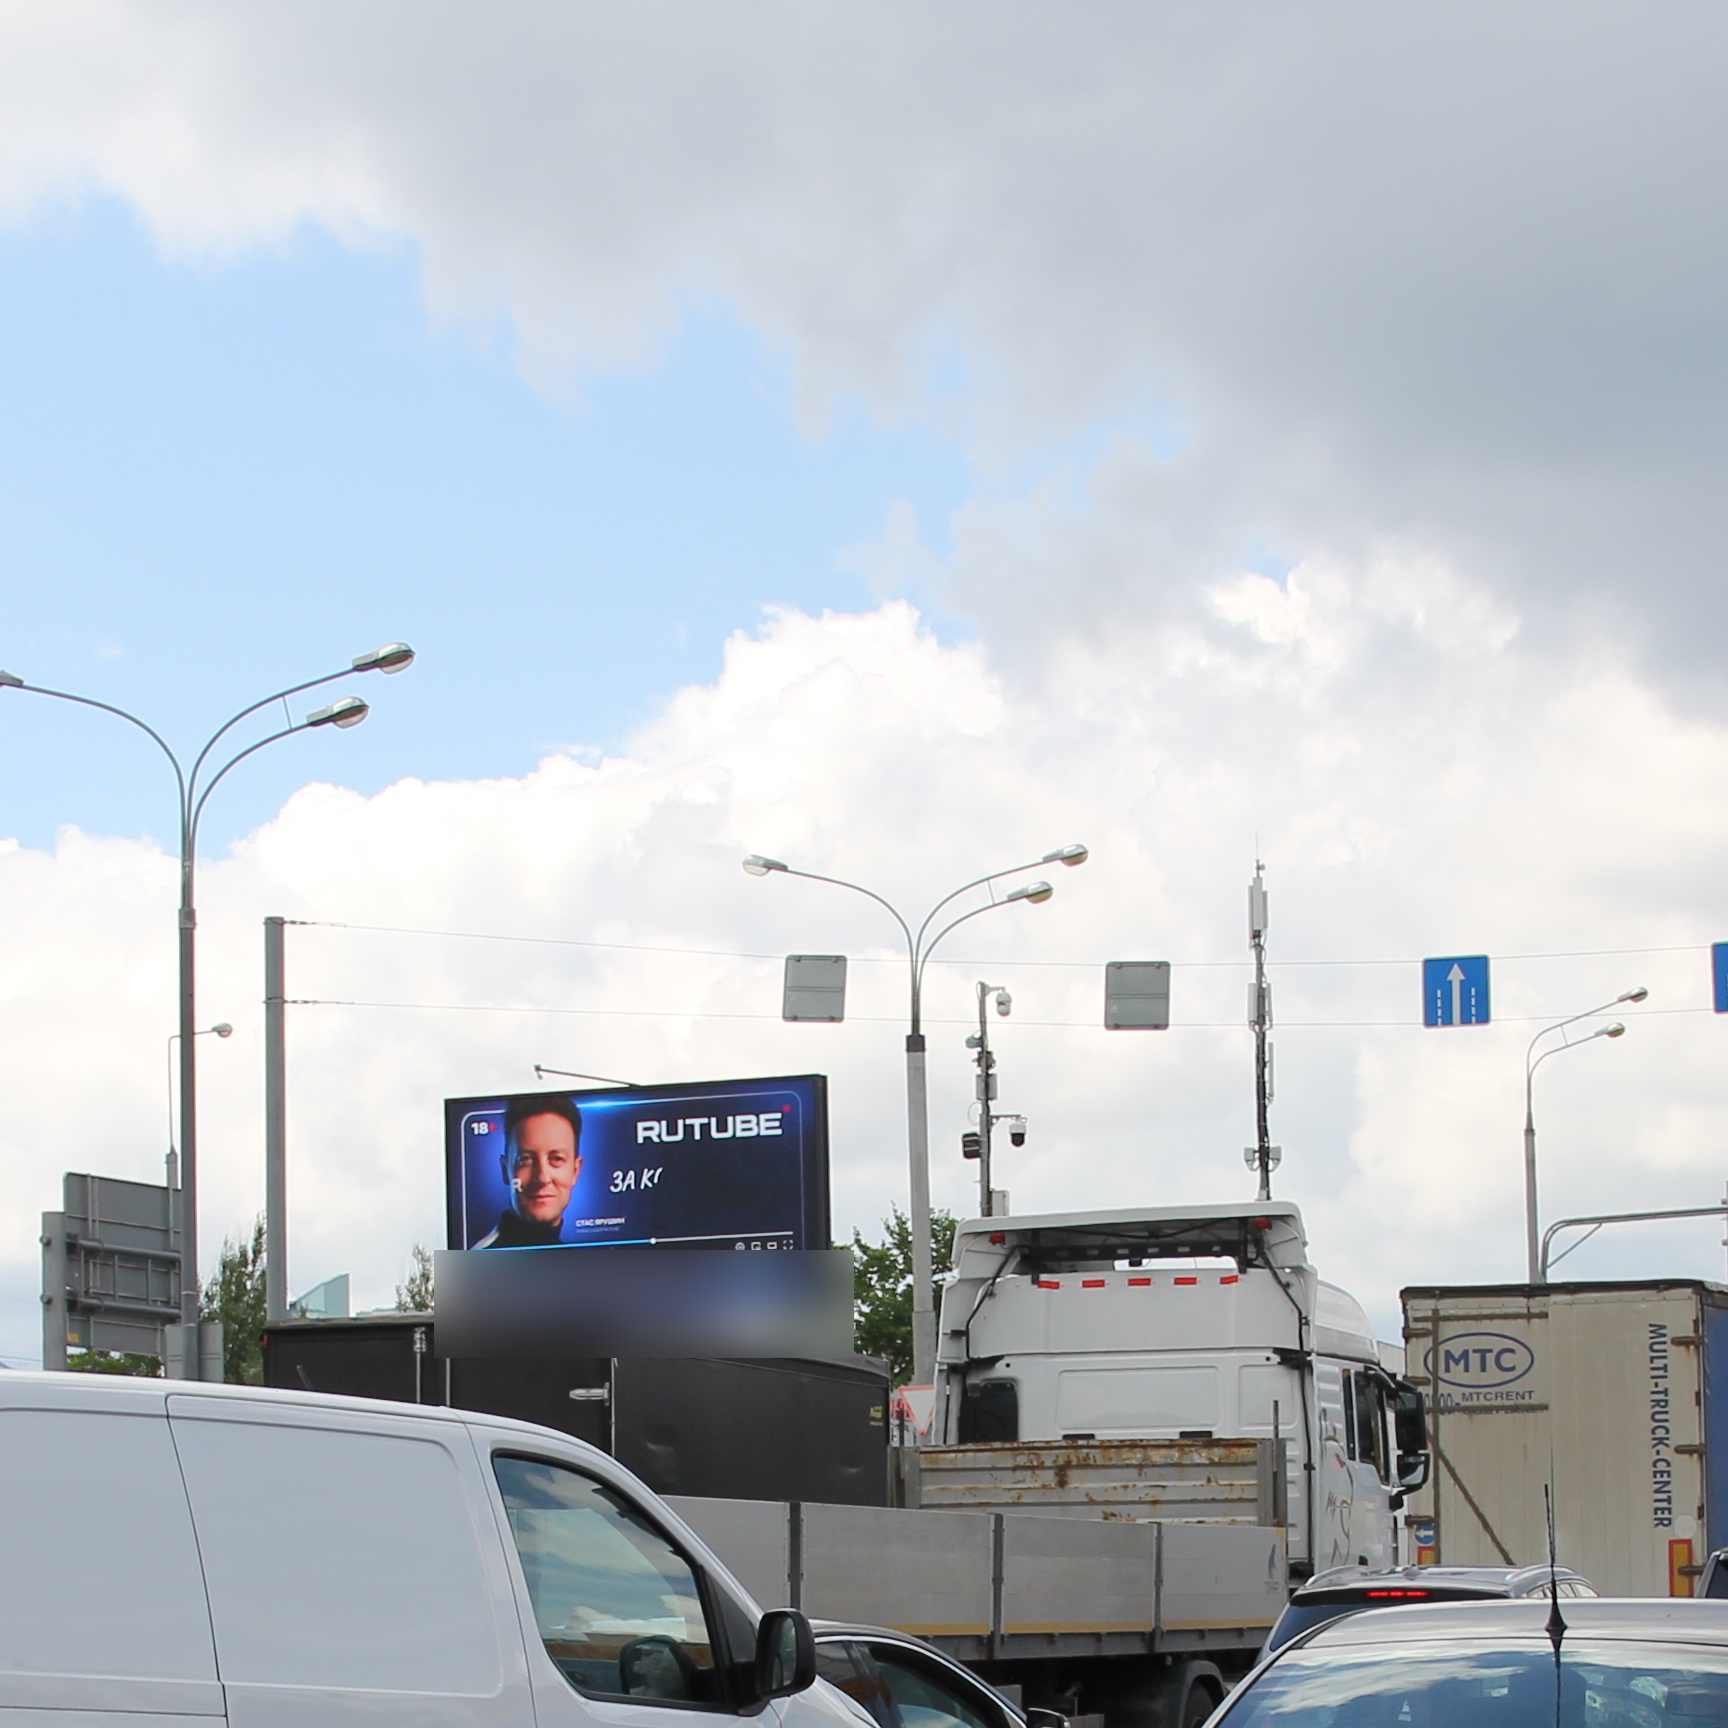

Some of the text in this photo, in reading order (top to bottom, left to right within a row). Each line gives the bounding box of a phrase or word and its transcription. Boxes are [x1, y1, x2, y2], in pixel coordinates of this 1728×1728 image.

[470, 1121, 497, 1136] 18+
[636, 1112, 782, 1144] RUTUBE
[609, 1169, 635, 1193] ЗА
[1443, 1348, 1517, 1373] MTC
[1648, 1323, 1672, 1528] MULTI-TRUCK-CENTER
